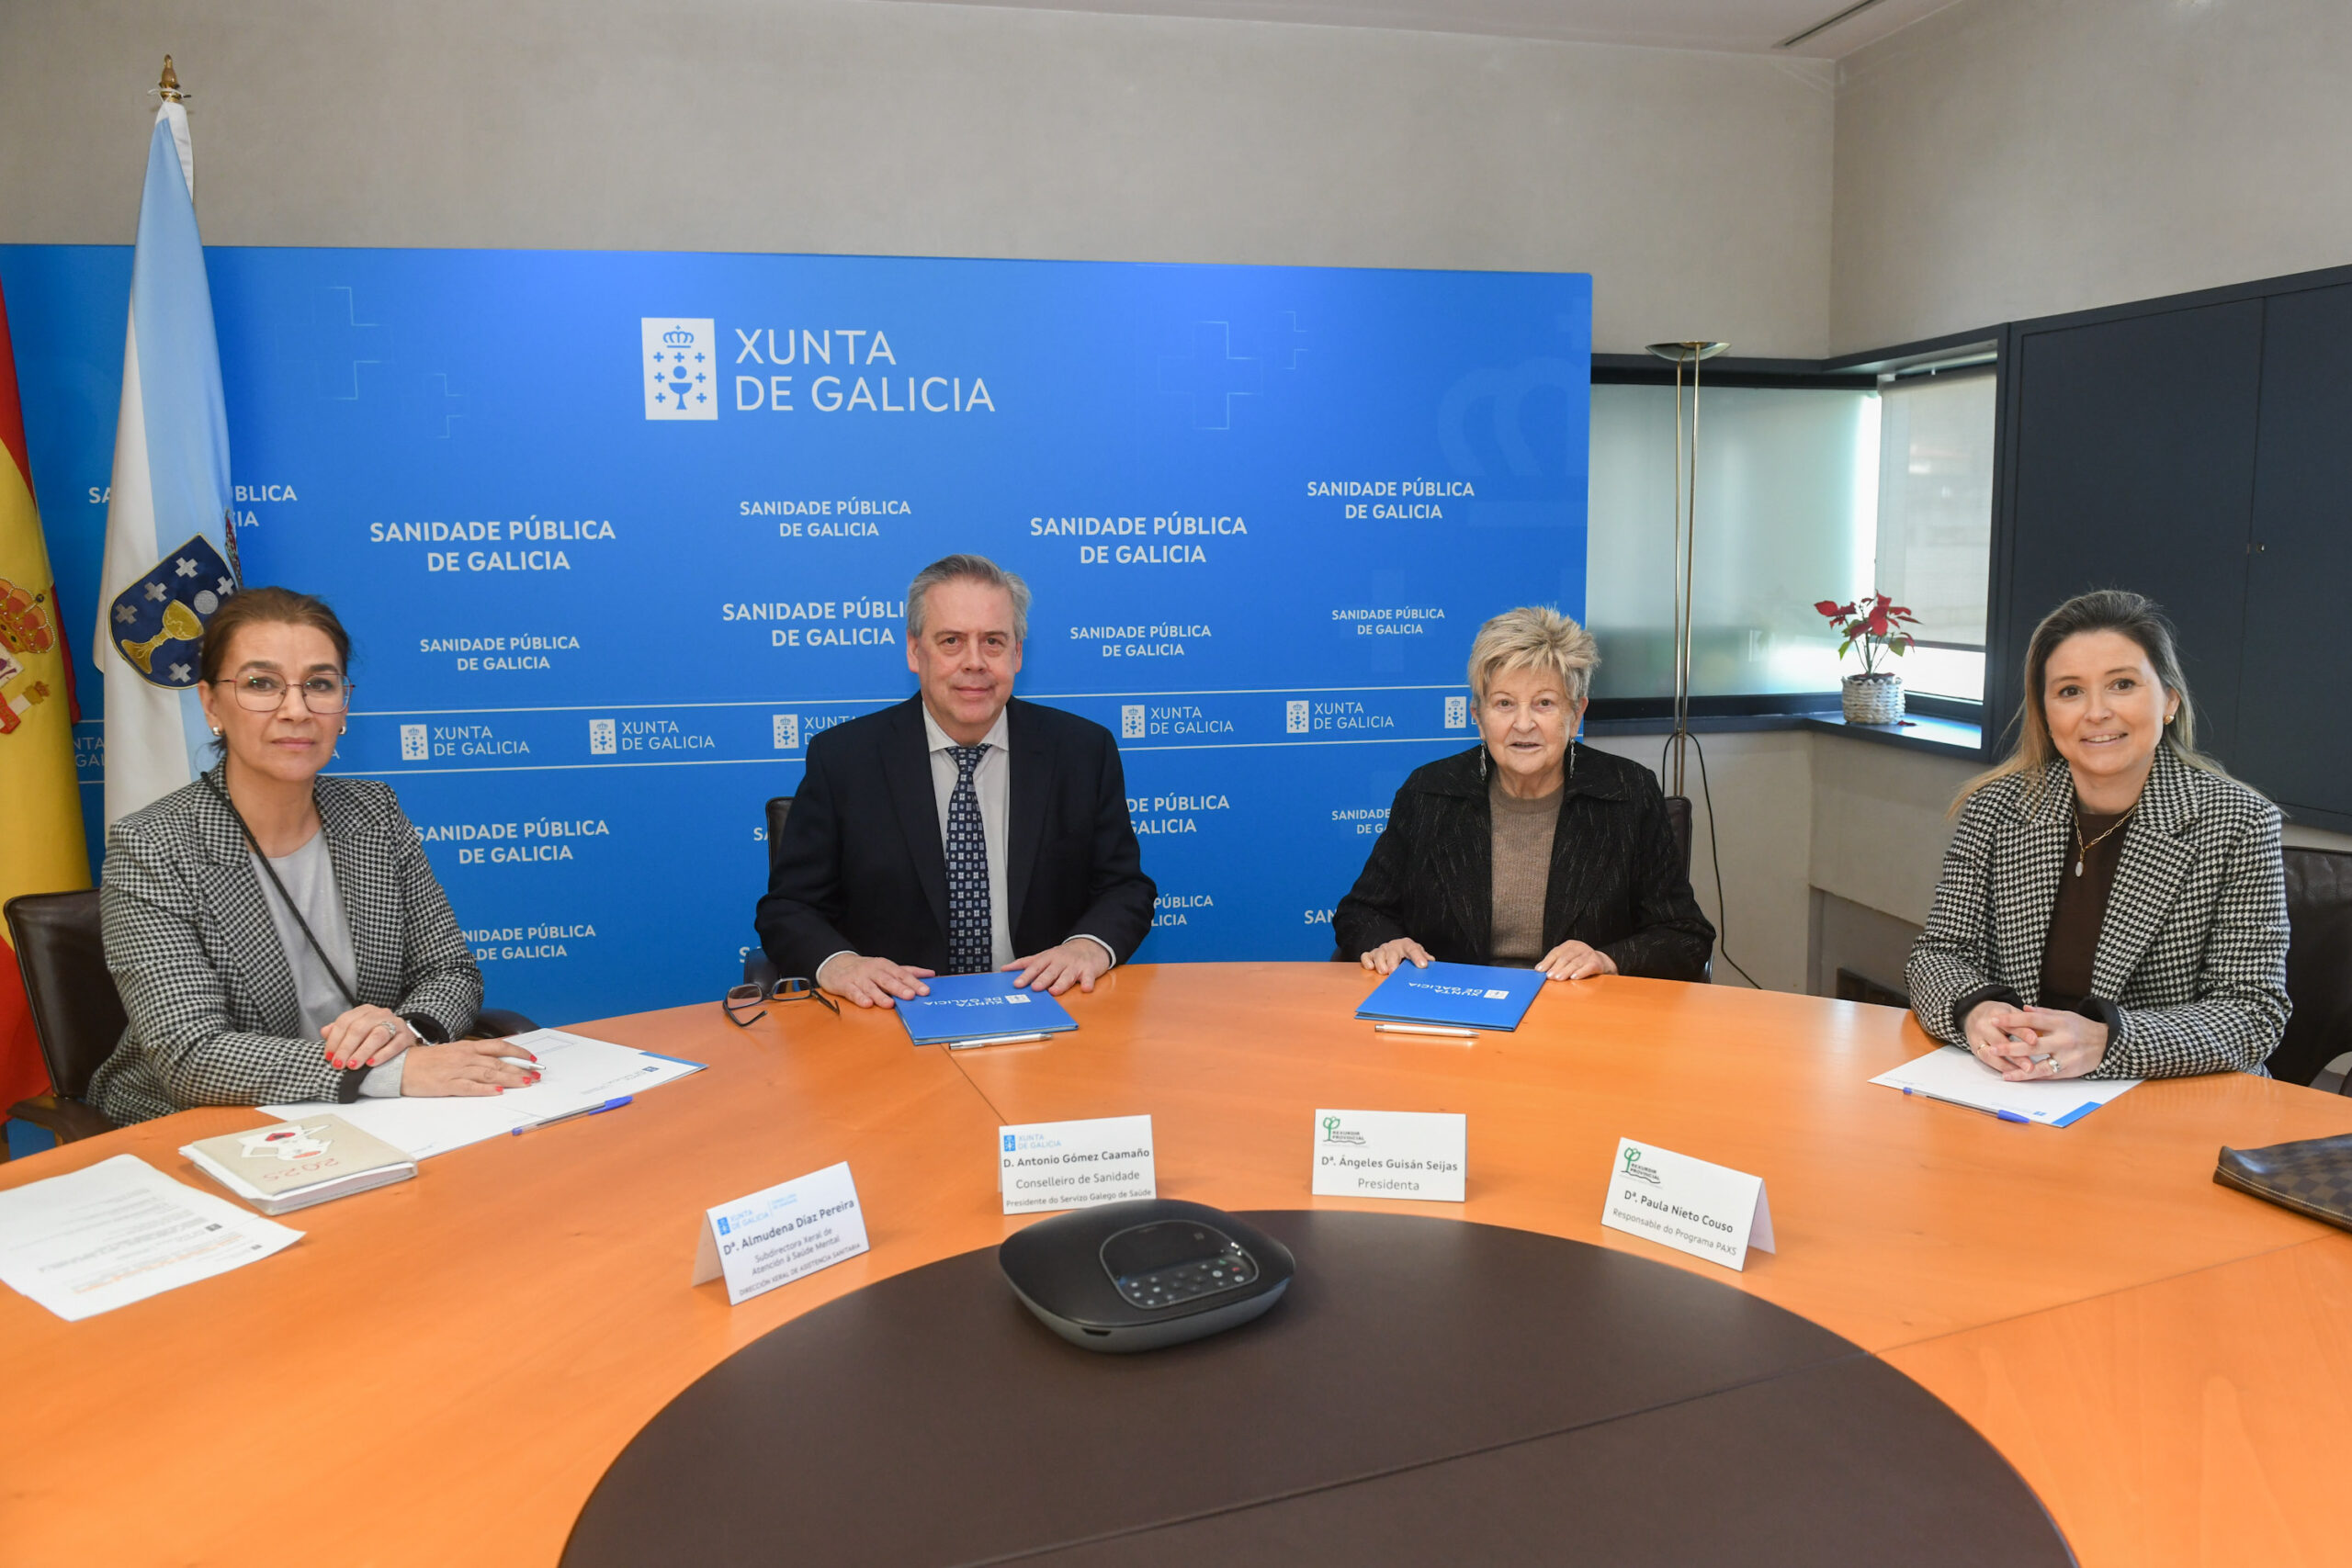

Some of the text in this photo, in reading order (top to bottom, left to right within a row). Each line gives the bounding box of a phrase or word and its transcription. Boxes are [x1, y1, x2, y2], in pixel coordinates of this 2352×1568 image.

[736, 329, 896, 365] XUNTA
[736, 376, 995, 412] DE GALICIA
[235, 485, 298, 502] BLICA
[1308, 478, 1474, 496] SANIDADE PÚBLICA
[741, 497, 910, 515] SANIDADE PÚBLICA
[1346, 504, 1442, 518] DE GALICIA
[370, 515, 616, 542] SANIDADE PÚBLICA
[780, 523, 878, 536] DE GALICIA
[1031, 512, 1247, 536] SANIDADE PÚBLICA
[428, 551, 570, 571] DE GALICIA
[1081, 546, 1205, 563] DE GALICIA
[723, 596, 904, 621] SANIDADE PÚBLI
[1332, 605, 1444, 621] SANIDADE PÚBLICA
[772, 628, 895, 646] DE GALICIA
[1071, 622, 1211, 639] SANIDADE PÚBLICA
[1358, 624, 1423, 635] DE GALICIA
[421, 633, 580, 650] SANIDADE PÚBLICA
[1102, 644, 1184, 657] DE GALICIA
[458, 657, 549, 671] DE GALICIA
[1151, 706, 1202, 719] XUNTA
[1315, 702, 1363, 715] XUNTA
[622, 721, 679, 734] XUNTA
[1150, 719, 1233, 734] DE GALICIA
[1314, 715, 1394, 729] DE GALICIA
[435, 727, 492, 739] XUNTA
[74, 737, 104, 750] NTA
[435, 740, 529, 756] DE GALICIA
[622, 736, 715, 750] DE GALICIA
[1155, 793, 1229, 811] PÚBLICA
[525, 818, 609, 838] PÚBLICA
[1357, 824, 1372, 834] DE
[459, 845, 572, 863] DE GALICIA
[1153, 893, 1214, 909] PÚBLICA
[1150, 914, 1188, 927] LICIA
[462, 923, 595, 942] NIDADE PÚBLICA
[476, 945, 567, 960] DE GALICIA
[1003, 1148, 1149, 1168] D. Antonio Gómez Caamaño
[1340, 1155, 1383, 1168] Ángeles
[1385, 1158, 1423, 1169] Guisán
[1426, 1160, 1458, 1173] Seijas
[1016, 1170, 1140, 1189] Conselleiro de Sanidade
[1358, 1178, 1419, 1190] Presidenta
[1006, 1199, 1046, 1207] Presidente
[1048, 1196, 1058, 1204] do
[1060, 1194, 1089, 1204] Servizo
[1089, 1191, 1117, 1202] Galego
[1129, 1188, 1151, 1197] Saúde
[1640, 1194, 1668, 1213] Paula
[1671, 1204, 1700, 1223] Nieto
[1702, 1214, 1734, 1233] Couso
[741, 1223, 794, 1248] Almudena
[796, 1213, 818, 1227] Díaz
[819, 1200, 854, 1219] Pereira
[1612, 1208, 1661, 1230] Responsable
[1663, 1224, 1674, 1235] do
[1676, 1228, 1713, 1248] Programa
[755, 1226, 833, 1263] Subdirectora Xeral de
[752, 1258, 786, 1275] Atención
[793, 1247, 814, 1260] Saúde
[816, 1235, 841, 1250] Mental
